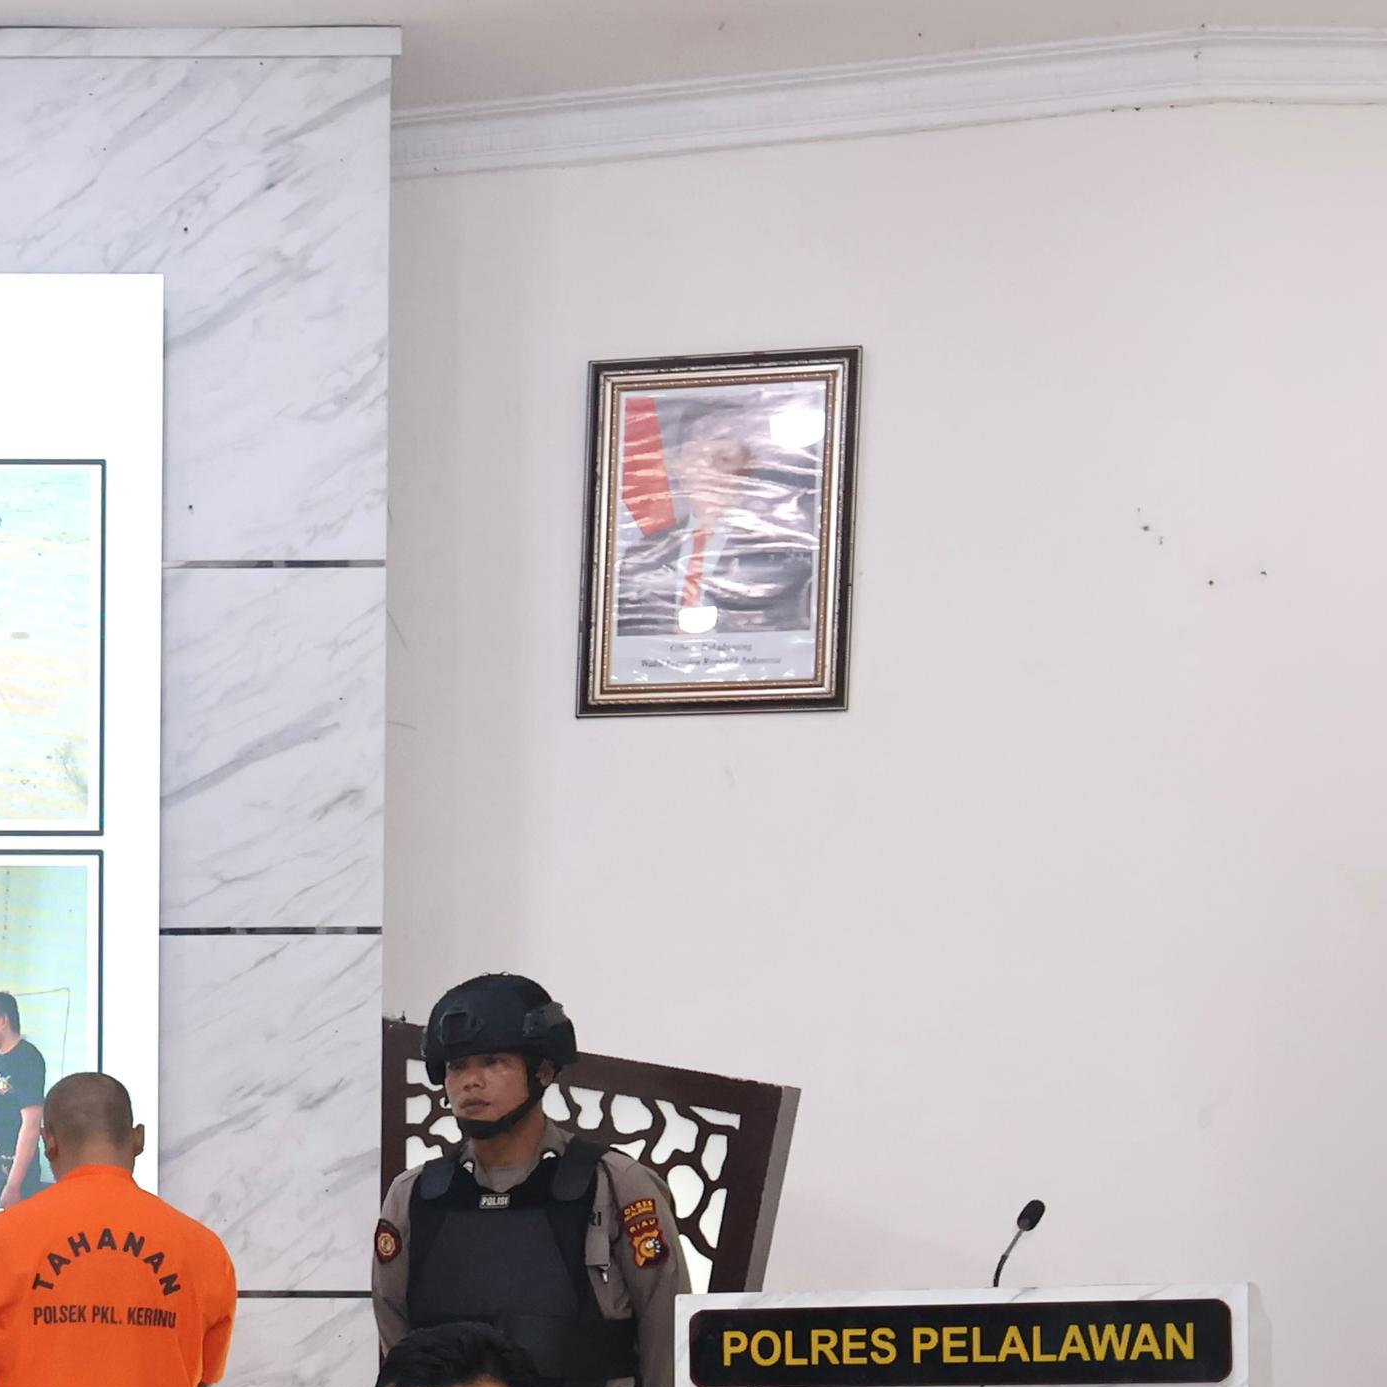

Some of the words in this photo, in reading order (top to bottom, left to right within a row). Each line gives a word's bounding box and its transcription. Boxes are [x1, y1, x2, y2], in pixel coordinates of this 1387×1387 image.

[32, 1228, 182, 1297] TAHANAN
[33, 1304, 87, 1325] POLSEK
[91, 1304, 122, 1324] PKL.
[722, 1328, 897, 1367] POLRES
[912, 1322, 1195, 1364] PELALAWAN
